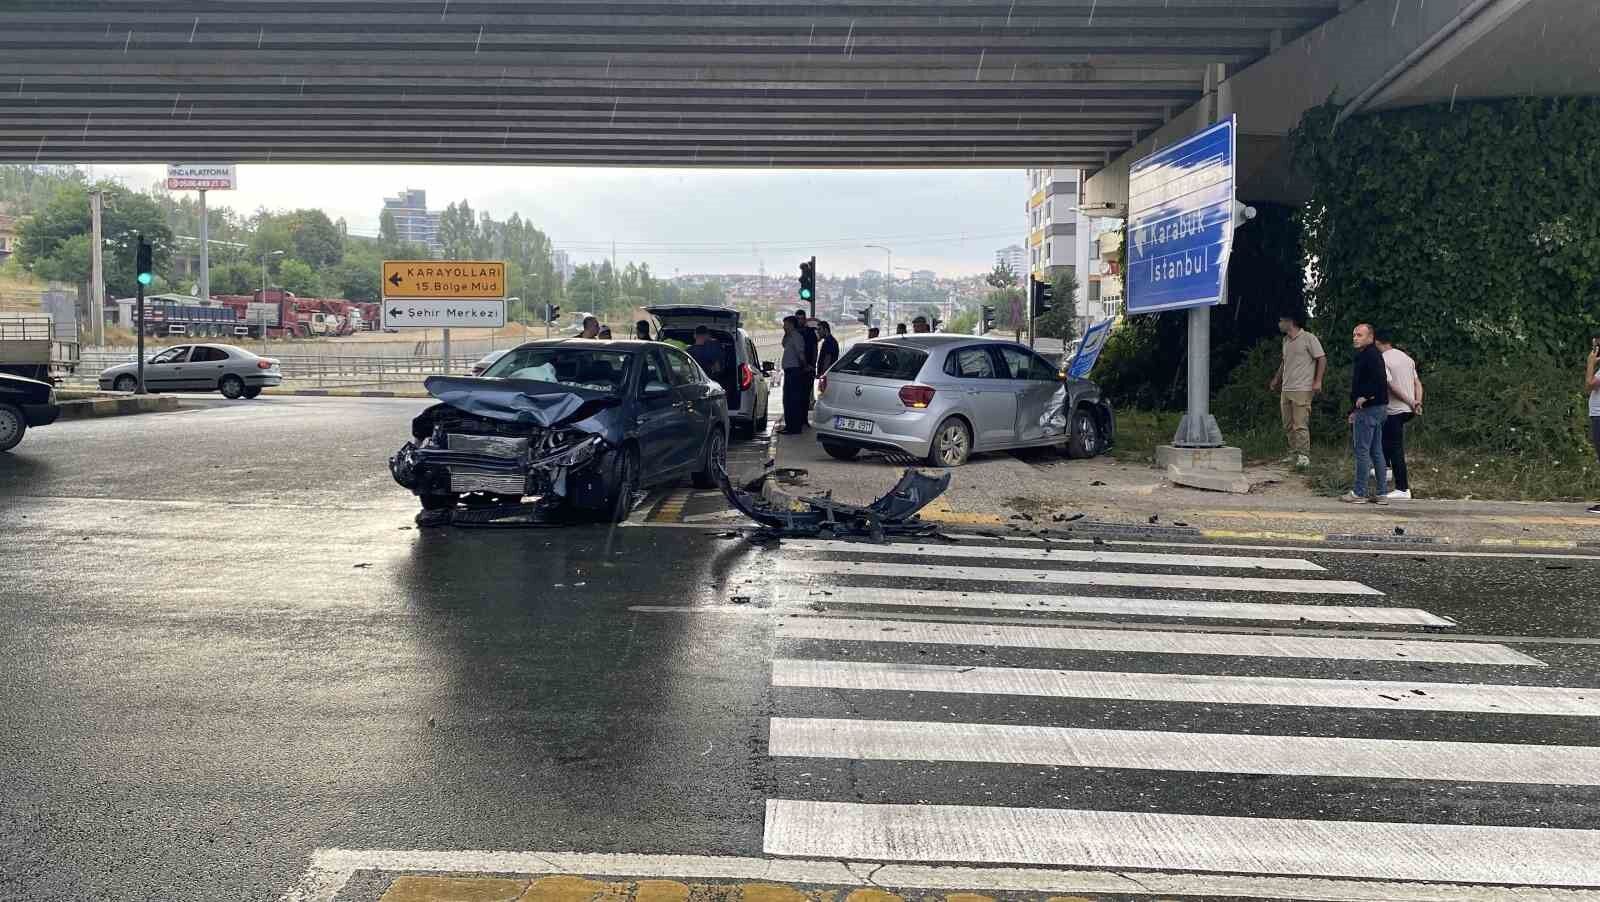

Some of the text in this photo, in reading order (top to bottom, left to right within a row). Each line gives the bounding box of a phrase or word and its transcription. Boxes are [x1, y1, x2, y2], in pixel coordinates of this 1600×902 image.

[408, 268, 500, 277] KARAYOLLARI
[408, 307, 498, 318] Şehir Merkezi
